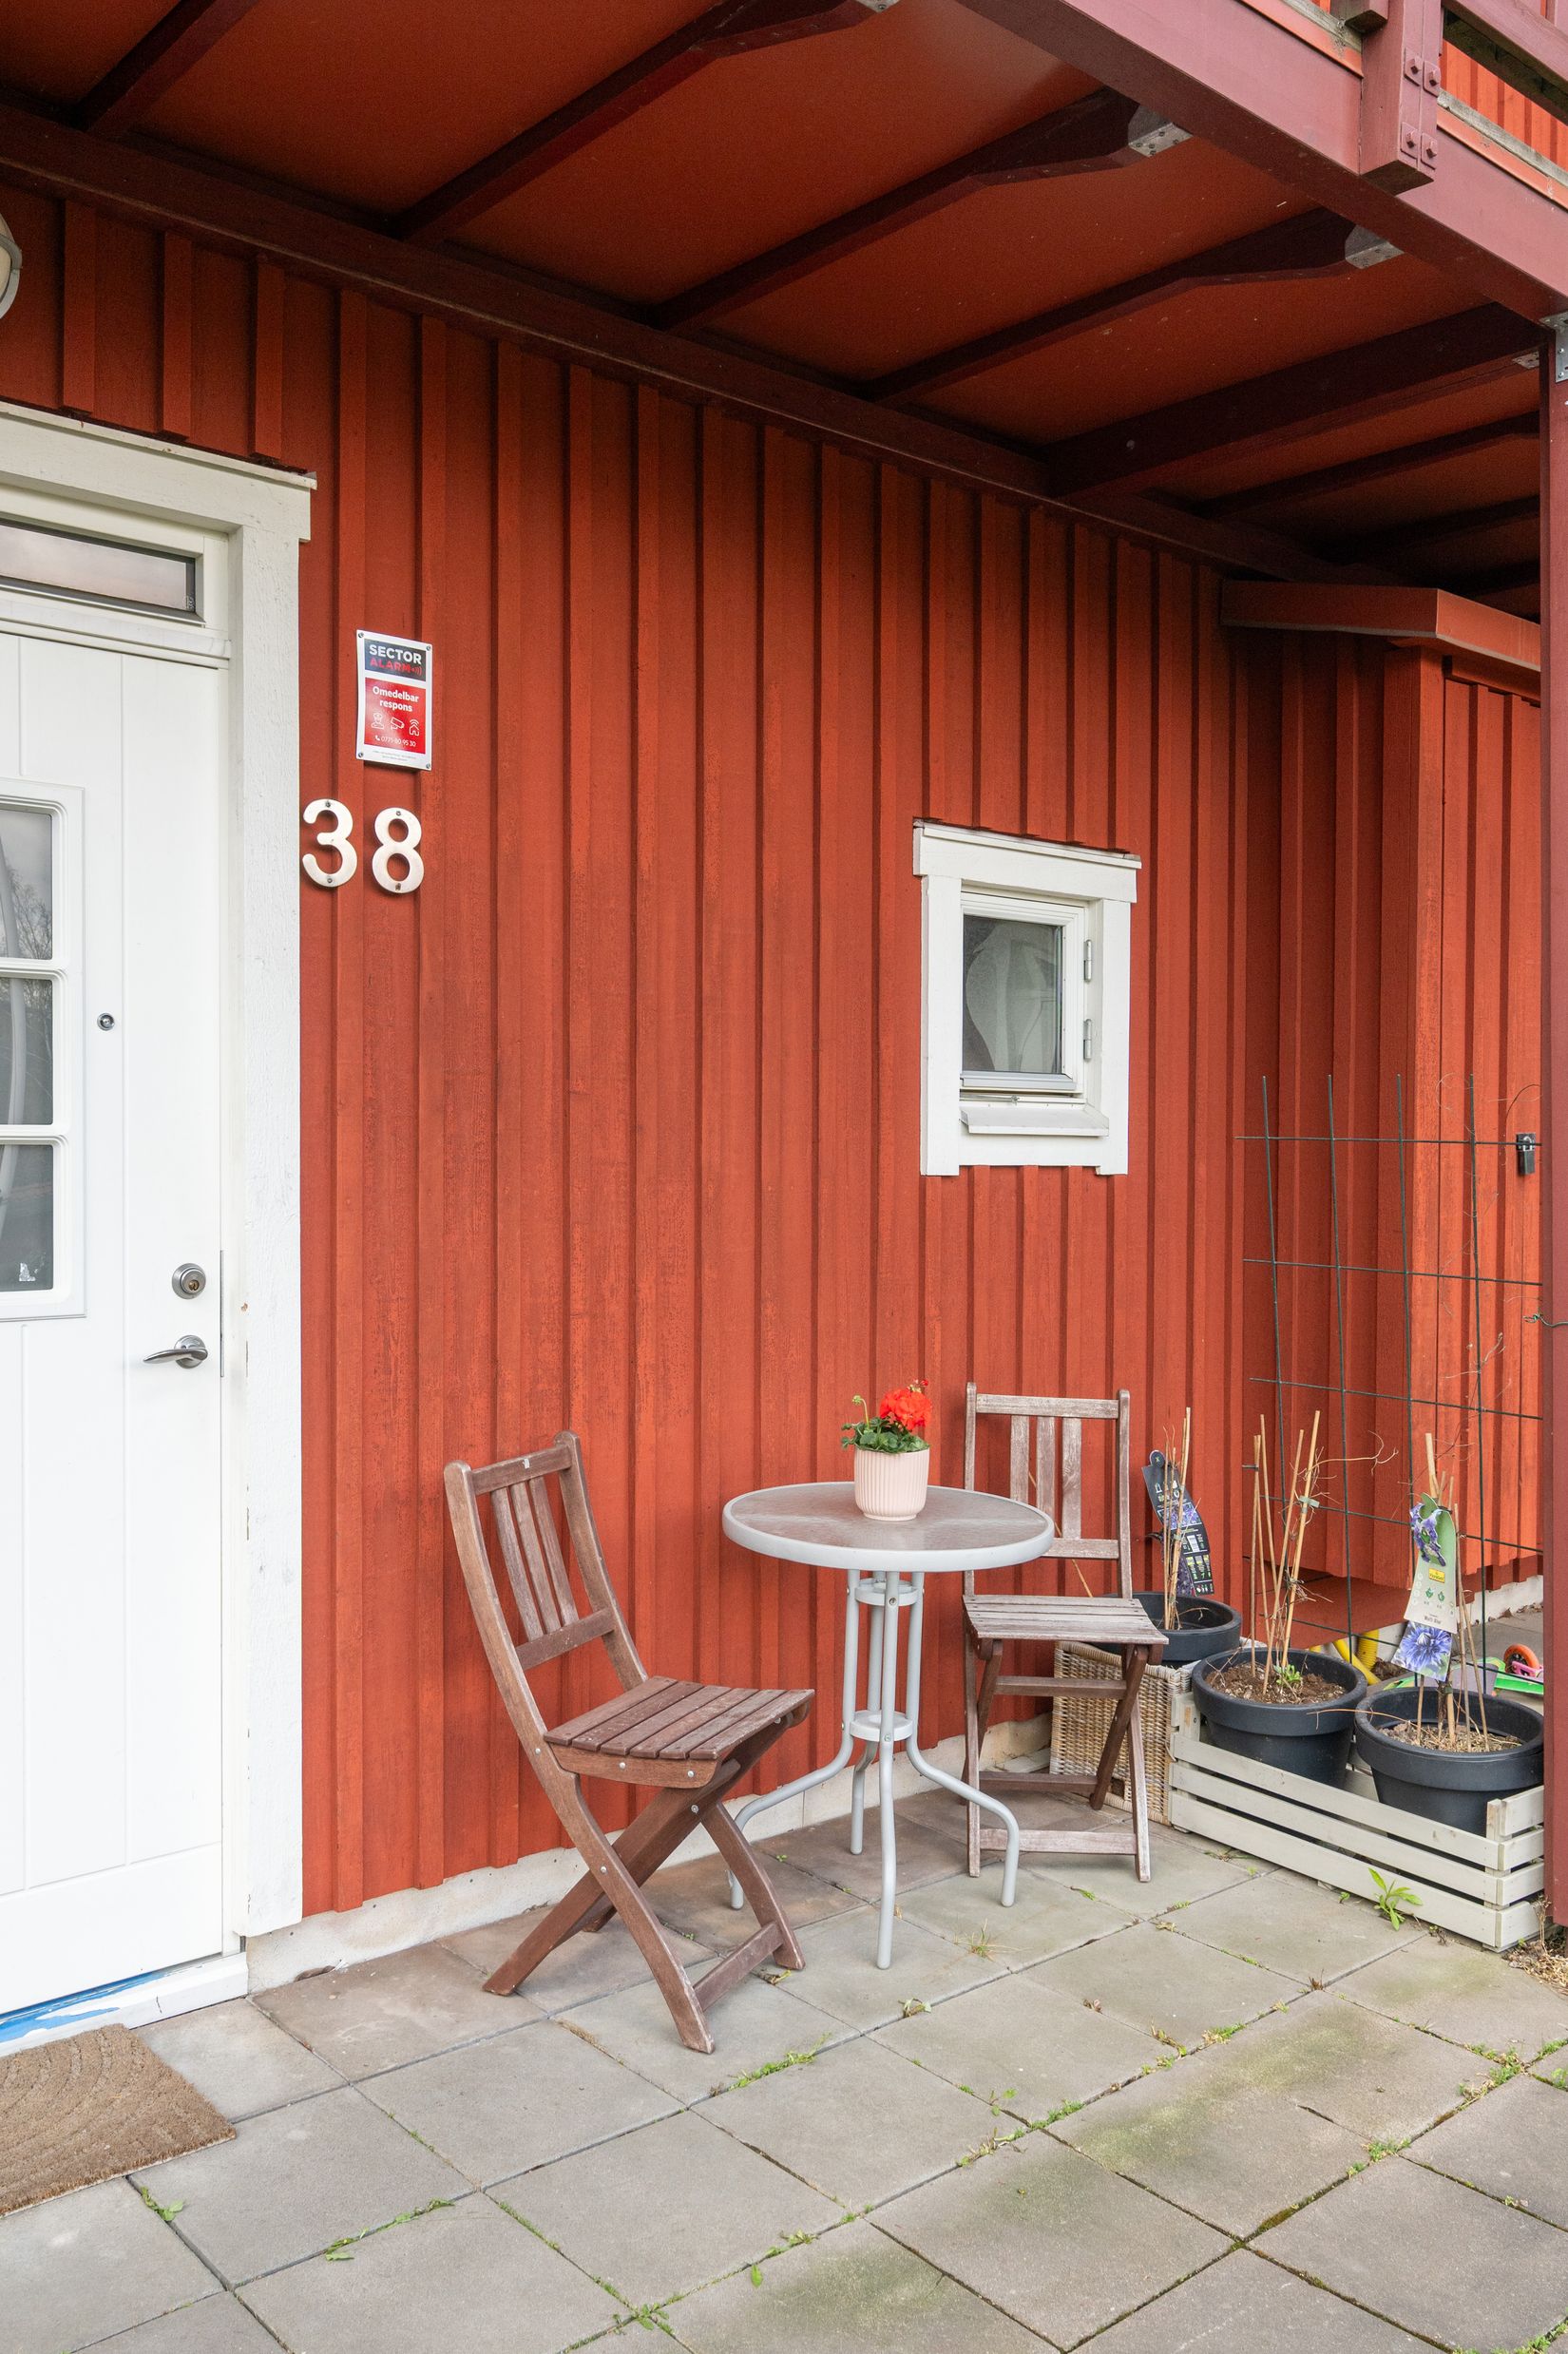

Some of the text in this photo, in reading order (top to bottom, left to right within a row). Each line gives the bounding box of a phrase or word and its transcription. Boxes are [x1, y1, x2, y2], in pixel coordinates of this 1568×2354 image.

[370, 644, 422, 664] SECTOR
[370, 657, 411, 673] ALARM
[373, 686, 419, 702] Omedelbar
[380, 699, 412, 712] respons
[402, 737, 410, 746] 95
[302, 798, 424, 893] 38
